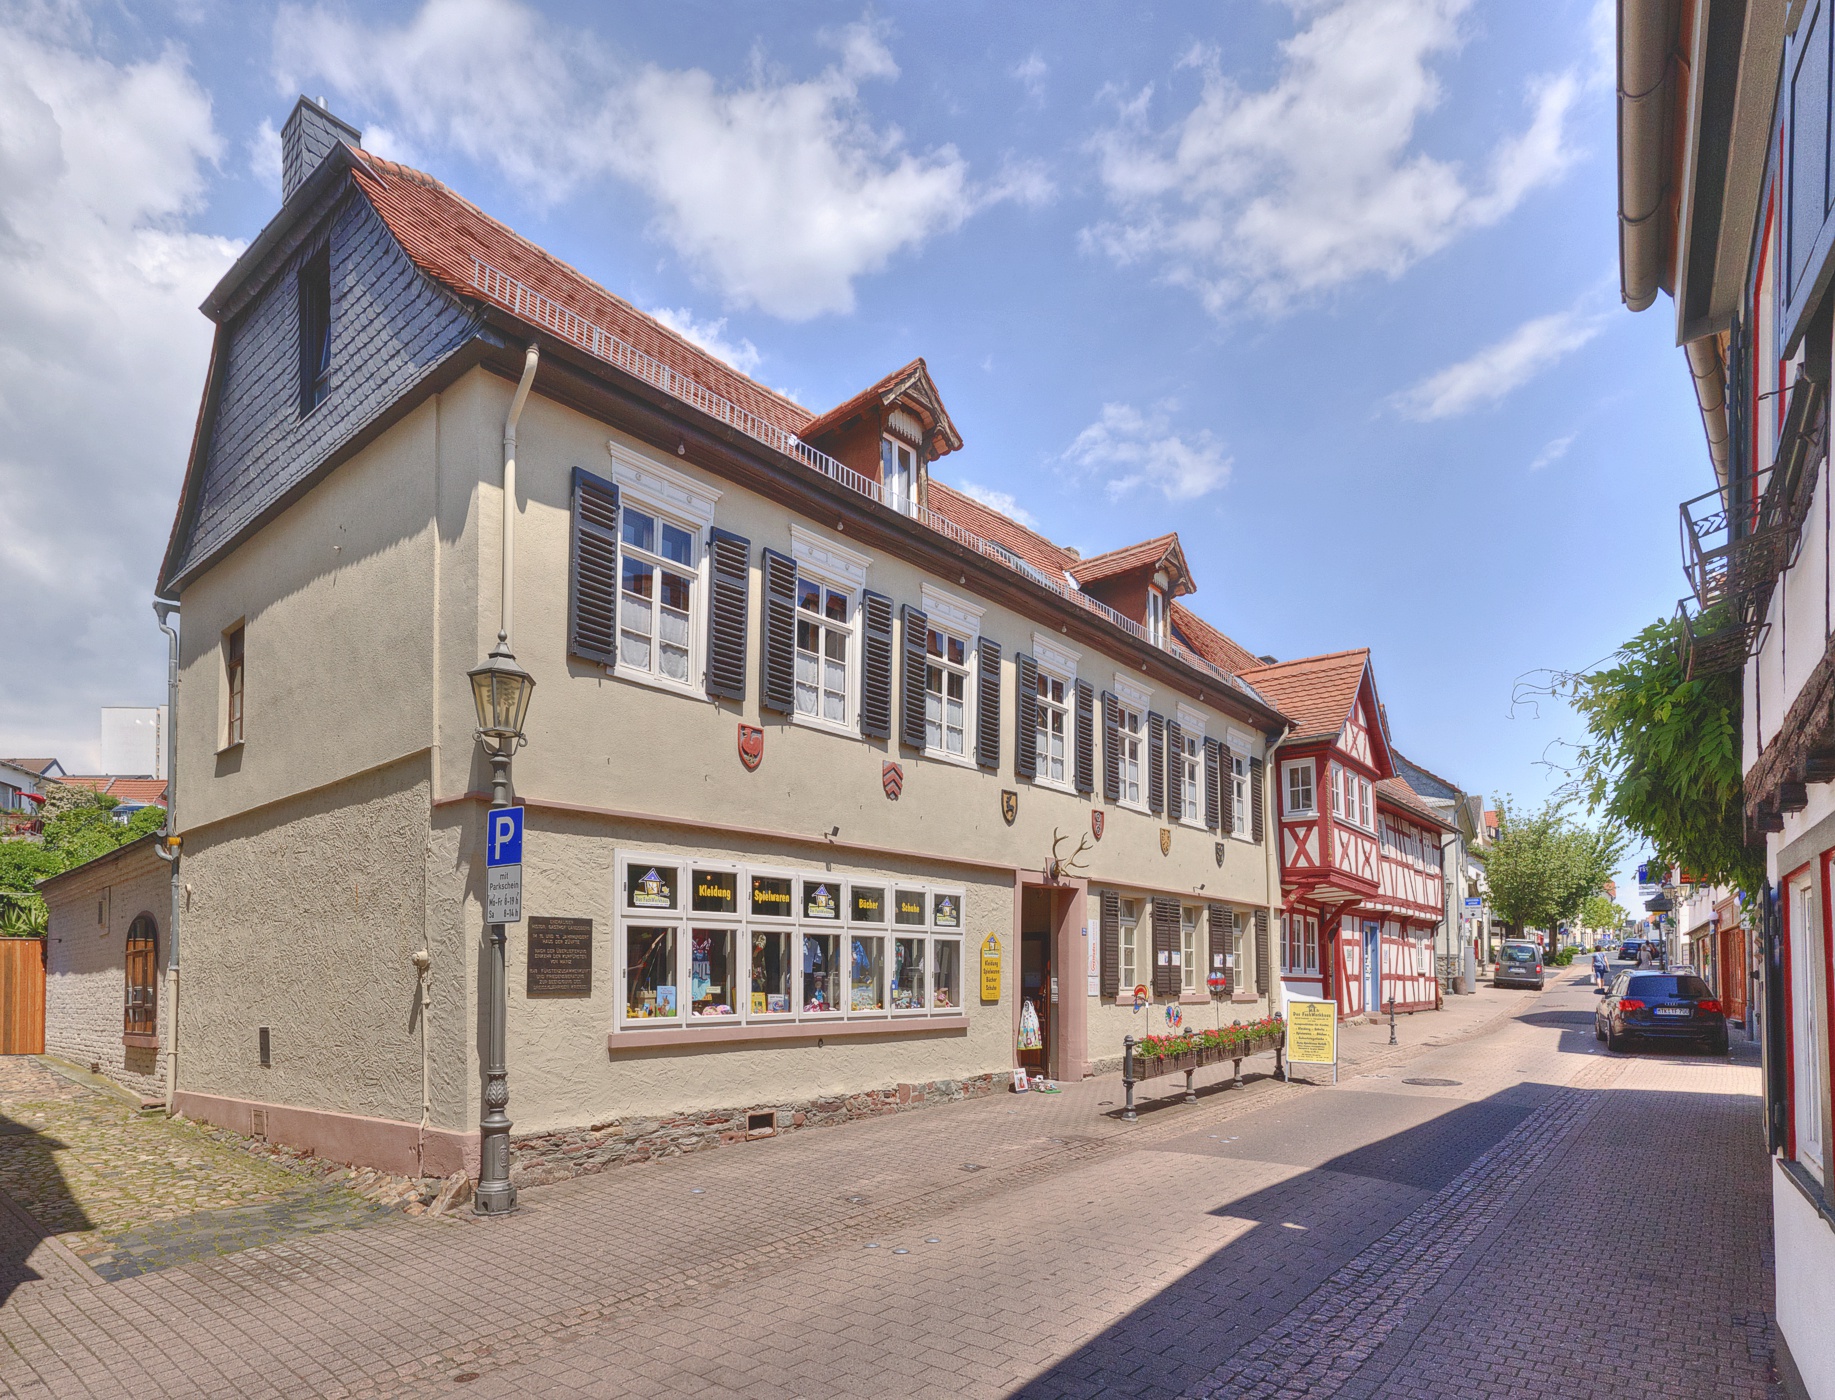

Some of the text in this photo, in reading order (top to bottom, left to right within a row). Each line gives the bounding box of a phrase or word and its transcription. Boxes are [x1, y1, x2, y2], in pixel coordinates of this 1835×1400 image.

[495, 816, 514, 859] P
[500, 872, 508, 880] mit
[489, 881, 519, 890] Parkschein
[699, 885, 731, 901] Kleidung
[754, 889, 790, 904] Spielwaren
[858, 898, 879, 910] Bücher
[901, 902, 920, 913] Schuhe
[489, 910, 495, 918] Sa
[504, 909, 515, 918] 8-14
[984, 959, 999, 968] Kleidung
[983, 967, 1000, 976] Spielwaren
